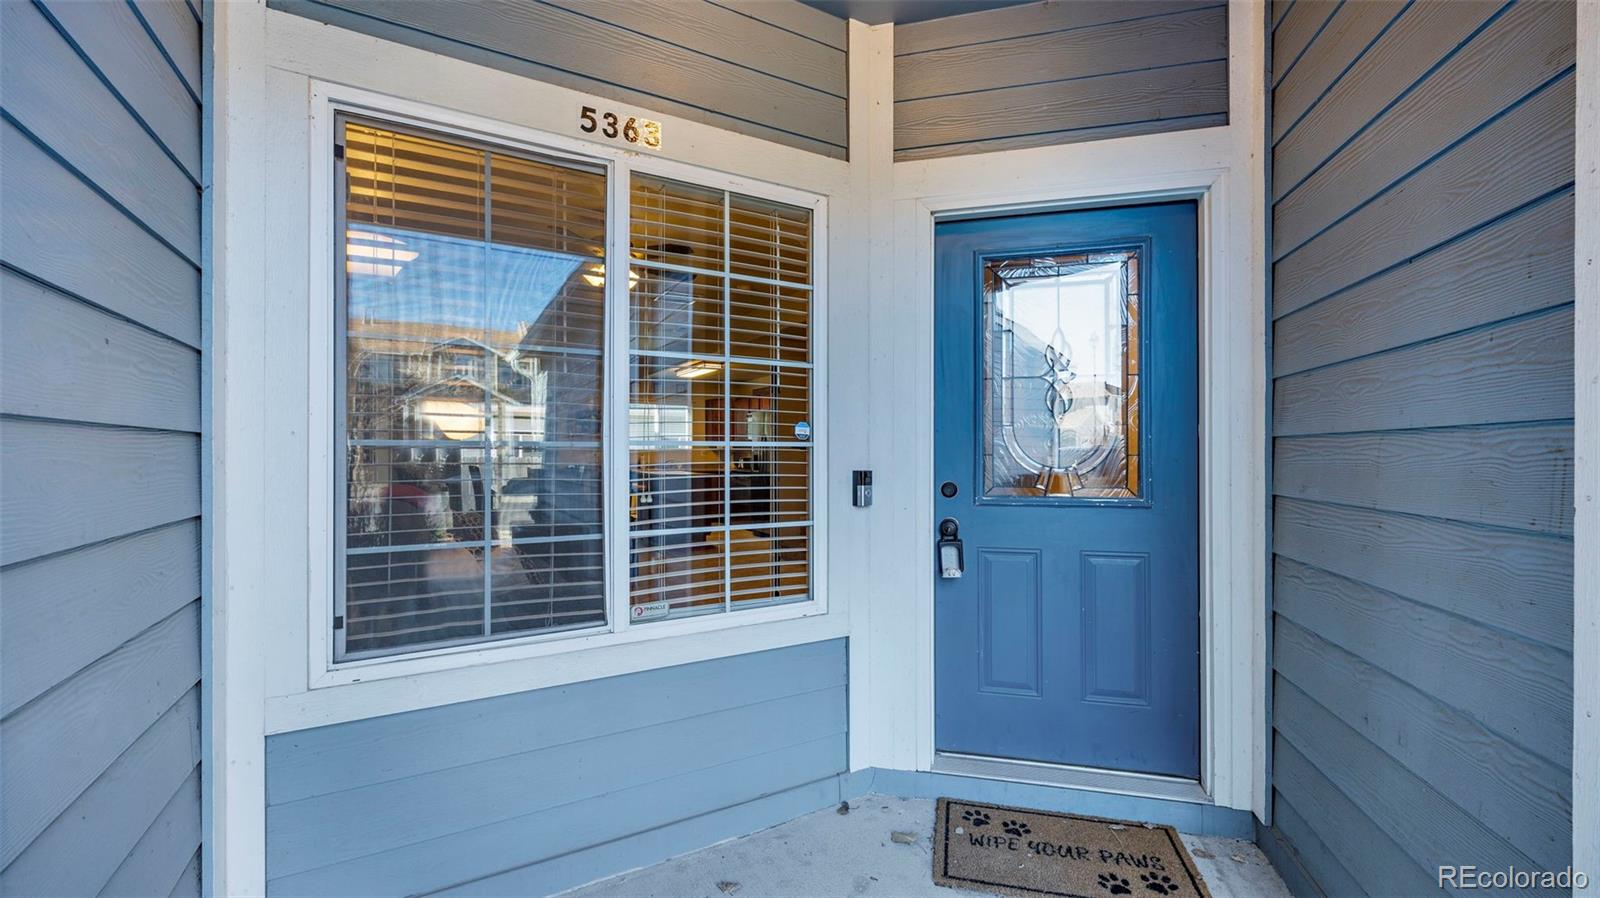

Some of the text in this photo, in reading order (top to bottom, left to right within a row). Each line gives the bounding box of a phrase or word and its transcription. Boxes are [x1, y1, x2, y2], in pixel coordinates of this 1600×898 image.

[580, 105, 660, 148] 5363
[969, 833, 1166, 871] WIPE YOUR PAWS
